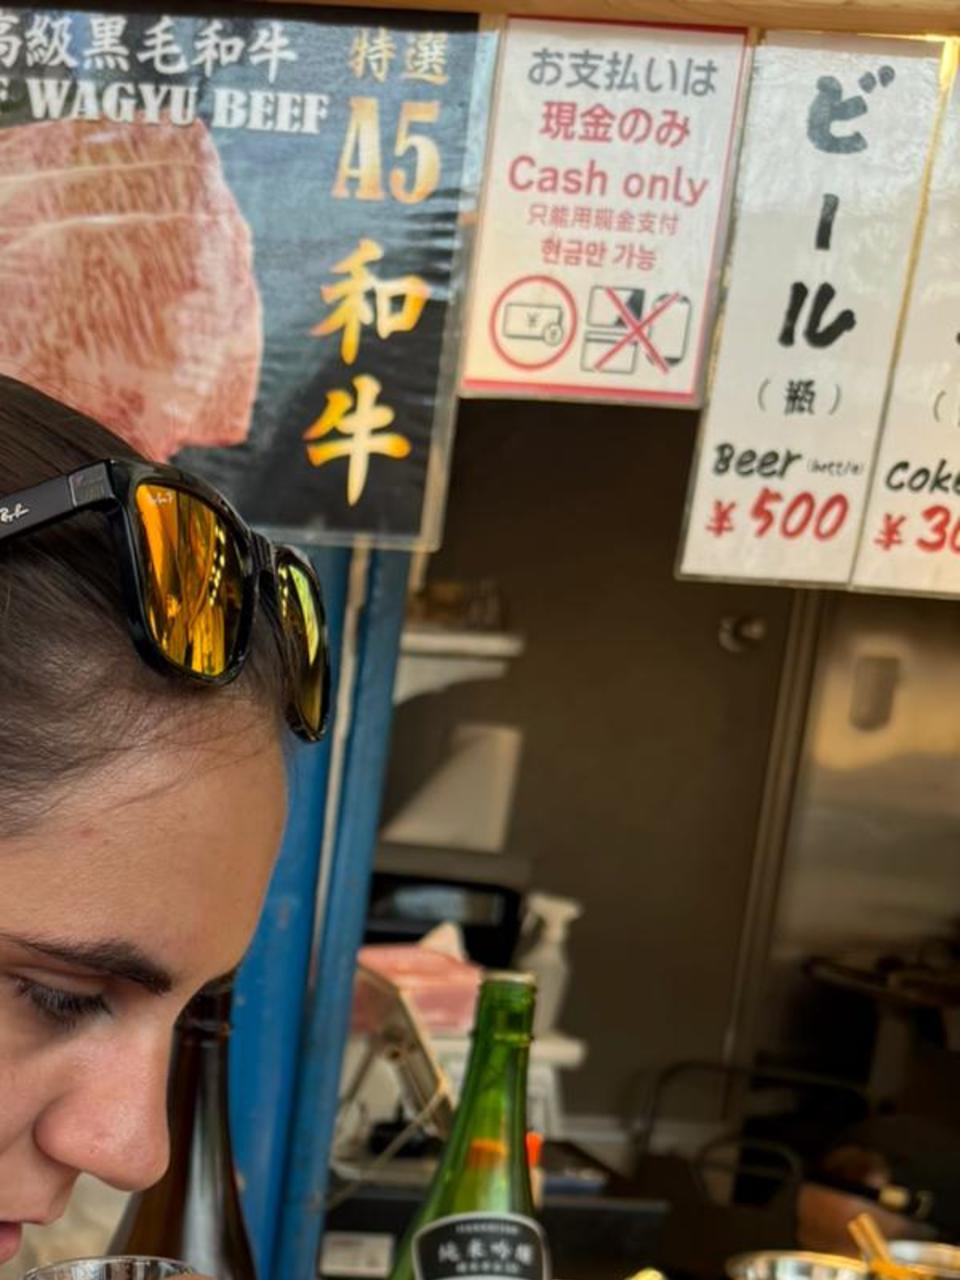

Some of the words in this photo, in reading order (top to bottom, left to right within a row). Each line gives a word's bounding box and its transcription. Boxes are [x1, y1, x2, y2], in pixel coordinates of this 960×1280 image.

[348, 27, 449, 85] 特選
[527, 47, 719, 97] お支払いは
[24, 78, 198, 127] WAGYU
[212, 87, 329, 136] BEEF
[539, 101, 691, 149] 現金のみ
[332, 95, 442, 204] A5
[508, 156, 608, 198] Cash
[623, 166, 709, 206] only
[777, 65, 896, 349] ビール
[541, 232, 608, 268] 현금만
[612, 242, 657, 271] 가능
[302, 238, 430, 507] 和牛
[713, 443, 802, 478] Beer
